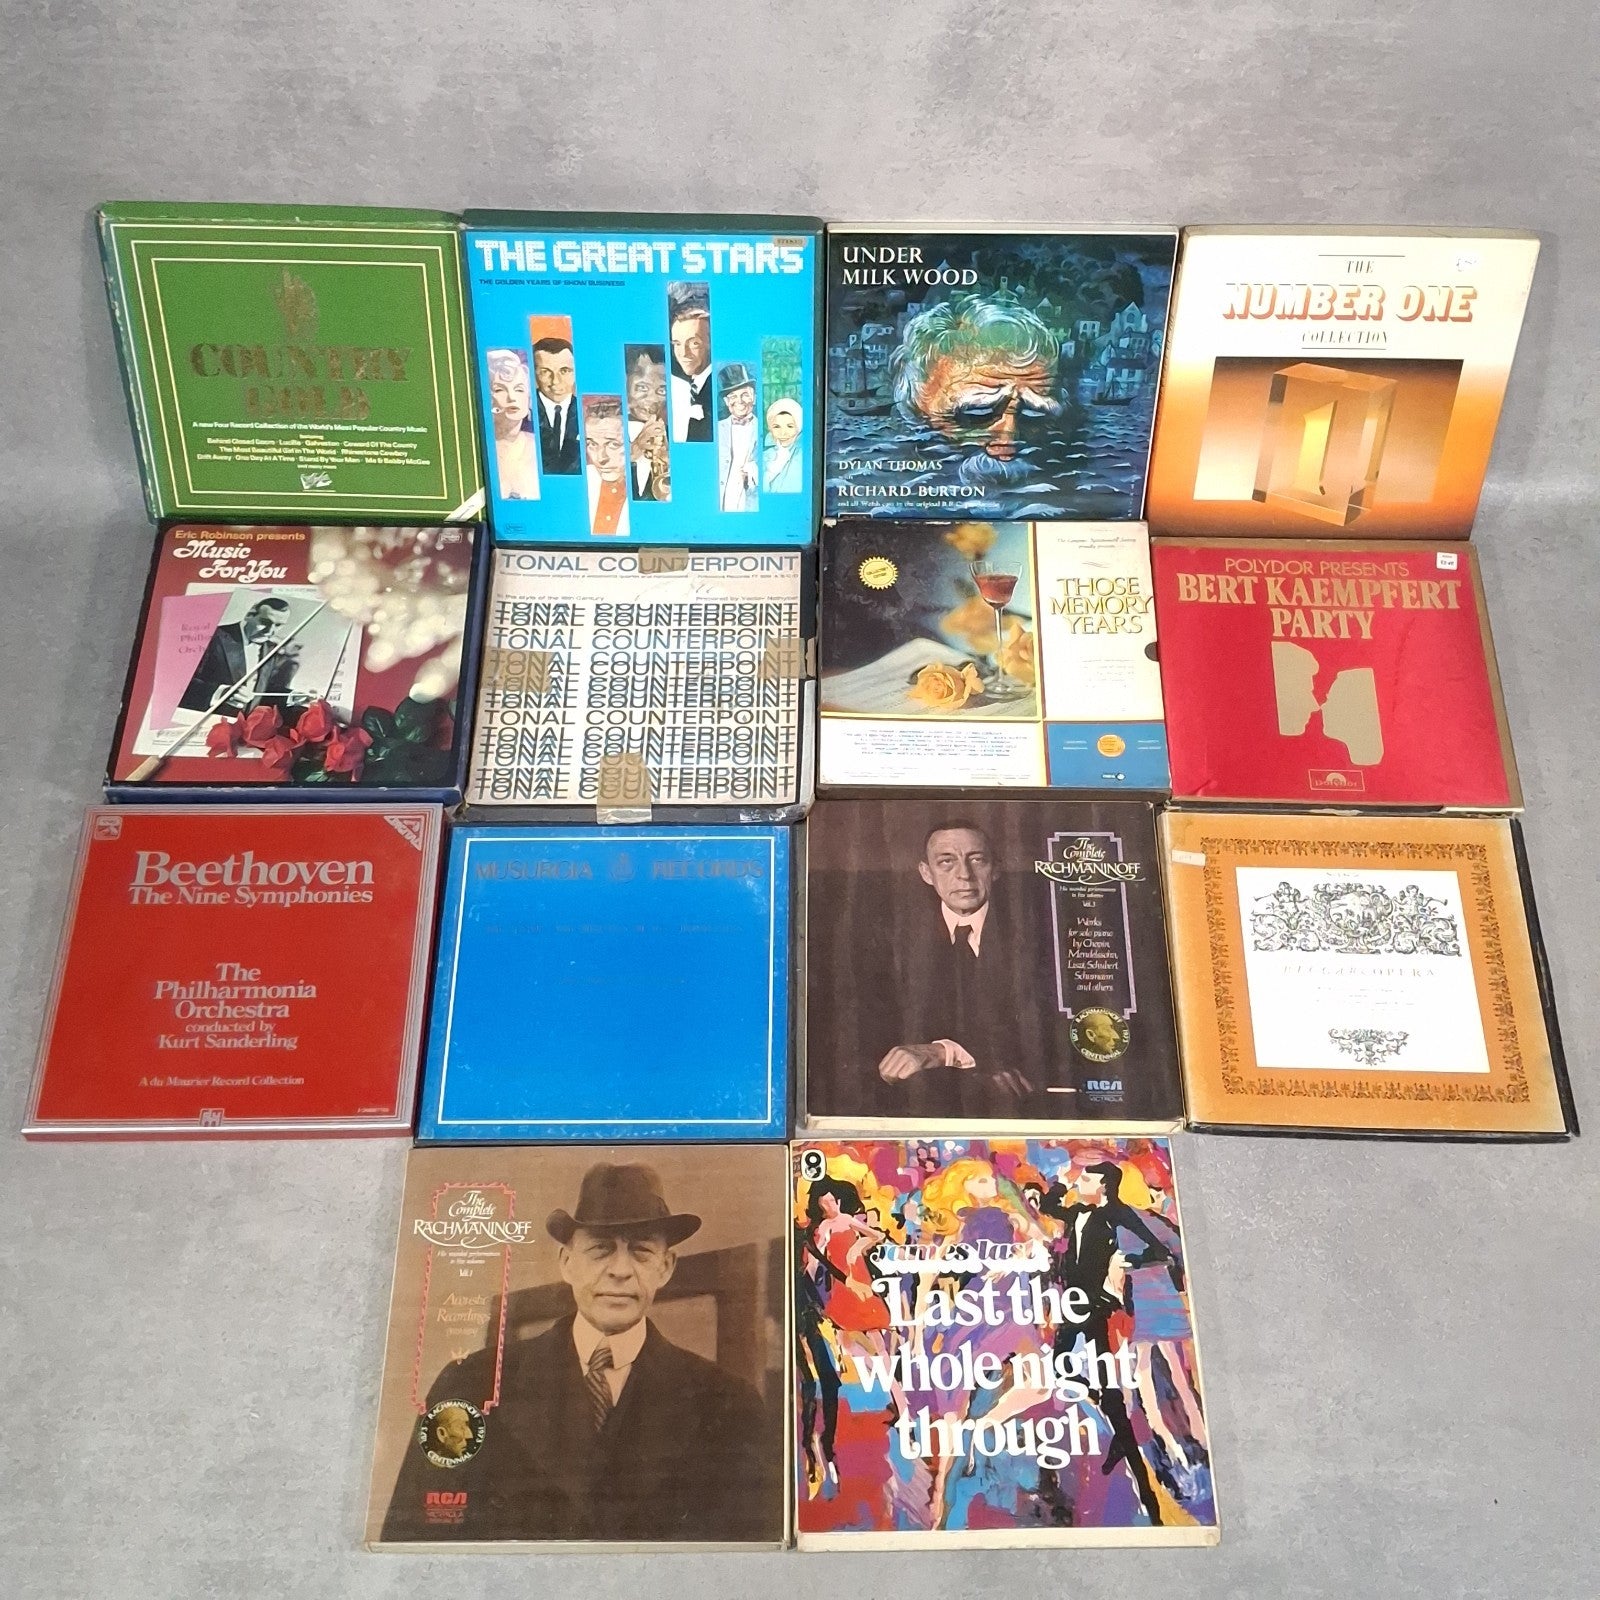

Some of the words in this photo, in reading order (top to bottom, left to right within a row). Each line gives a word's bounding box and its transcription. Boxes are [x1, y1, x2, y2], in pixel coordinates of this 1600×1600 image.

[475, 240, 547, 271] THE
[552, 240, 676, 273] GREAT
[681, 241, 804, 274] STARS
[843, 246, 923, 264] UNDER
[1346, 260, 1374, 274] THE
[841, 268, 896, 285] MILK
[903, 268, 978, 286] WOOD
[1222, 283, 1386, 321] NUMBER
[1396, 285, 1478, 322] ONE
[1302, 330, 1388, 344] COLLECTION
[379, 425, 406, 433] Country
[839, 461, 883, 470] DYLAN
[888, 461, 942, 471] THOMAS
[838, 485, 912, 497] RICHARD
[918, 486, 985, 497] BURTON
[175, 531, 197, 540] Eric
[200, 532, 253, 541] Robinson
[256, 532, 306, 541] presents
[173, 540, 251, 559] Music
[501, 553, 588, 571] TONAL
[1224, 558, 1314, 576] POLYDOR
[1320, 561, 1409, 577] PRESENTS
[199, 559, 246, 579] For
[238, 559, 288, 584] You
[1056, 577, 1141, 597] THOSE
[1176, 572, 1258, 605] BERT
[1265, 576, 1462, 609] KAEMPFERT
[1049, 596, 1154, 615] MEMORY
[1063, 616, 1143, 635] YEARS
[1270, 608, 1375, 639] PARTY
[485, 710, 576, 726] TONAL
[585, 710, 797, 726] COUNTERPOINT
[1073, 837, 1095, 850] The
[1063, 846, 1106, 862] Complete
[130, 850, 375, 886] Beethoven
[1034, 861, 1144, 880] RACHMANINOFF
[129, 886, 173, 905] The
[177, 886, 231, 905] Nine
[234, 885, 374, 908] Symphonies
[1077, 917, 1103, 926] Works
[1067, 930, 1078, 938] for
[1079, 929, 1092, 937] solo
[216, 962, 261, 982] The
[153, 979, 317, 1000] Philharmonia
[1076, 983, 1092, 992] and
[175, 1000, 290, 1019] Orchestra
[185, 1021, 255, 1033] conducted
[259, 1020, 276, 1033] by
[159, 1034, 200, 1049] Kurt
[204, 1033, 298, 1050] Sanderling
[211, 1076, 250, 1087] Record
[251, 1075, 305, 1086] Collection
[1086, 1080, 1123, 1091] RCA
[463, 1190, 485, 1206] The
[448, 1201, 497, 1222] Complete
[413, 1219, 533, 1242] RACHMANINOFF
[871, 1277, 1005, 1327] Last
[1006, 1276, 1092, 1327] the
[852, 1341, 1002, 1393] whole
[1007, 1341, 1141, 1402] night
[427, 1401, 481, 1420] RACHMANINOFF
[896, 1406, 1102, 1470] through
[427, 1450, 473, 1466] CENTENNIAL
[426, 1492, 468, 1505] RCA
